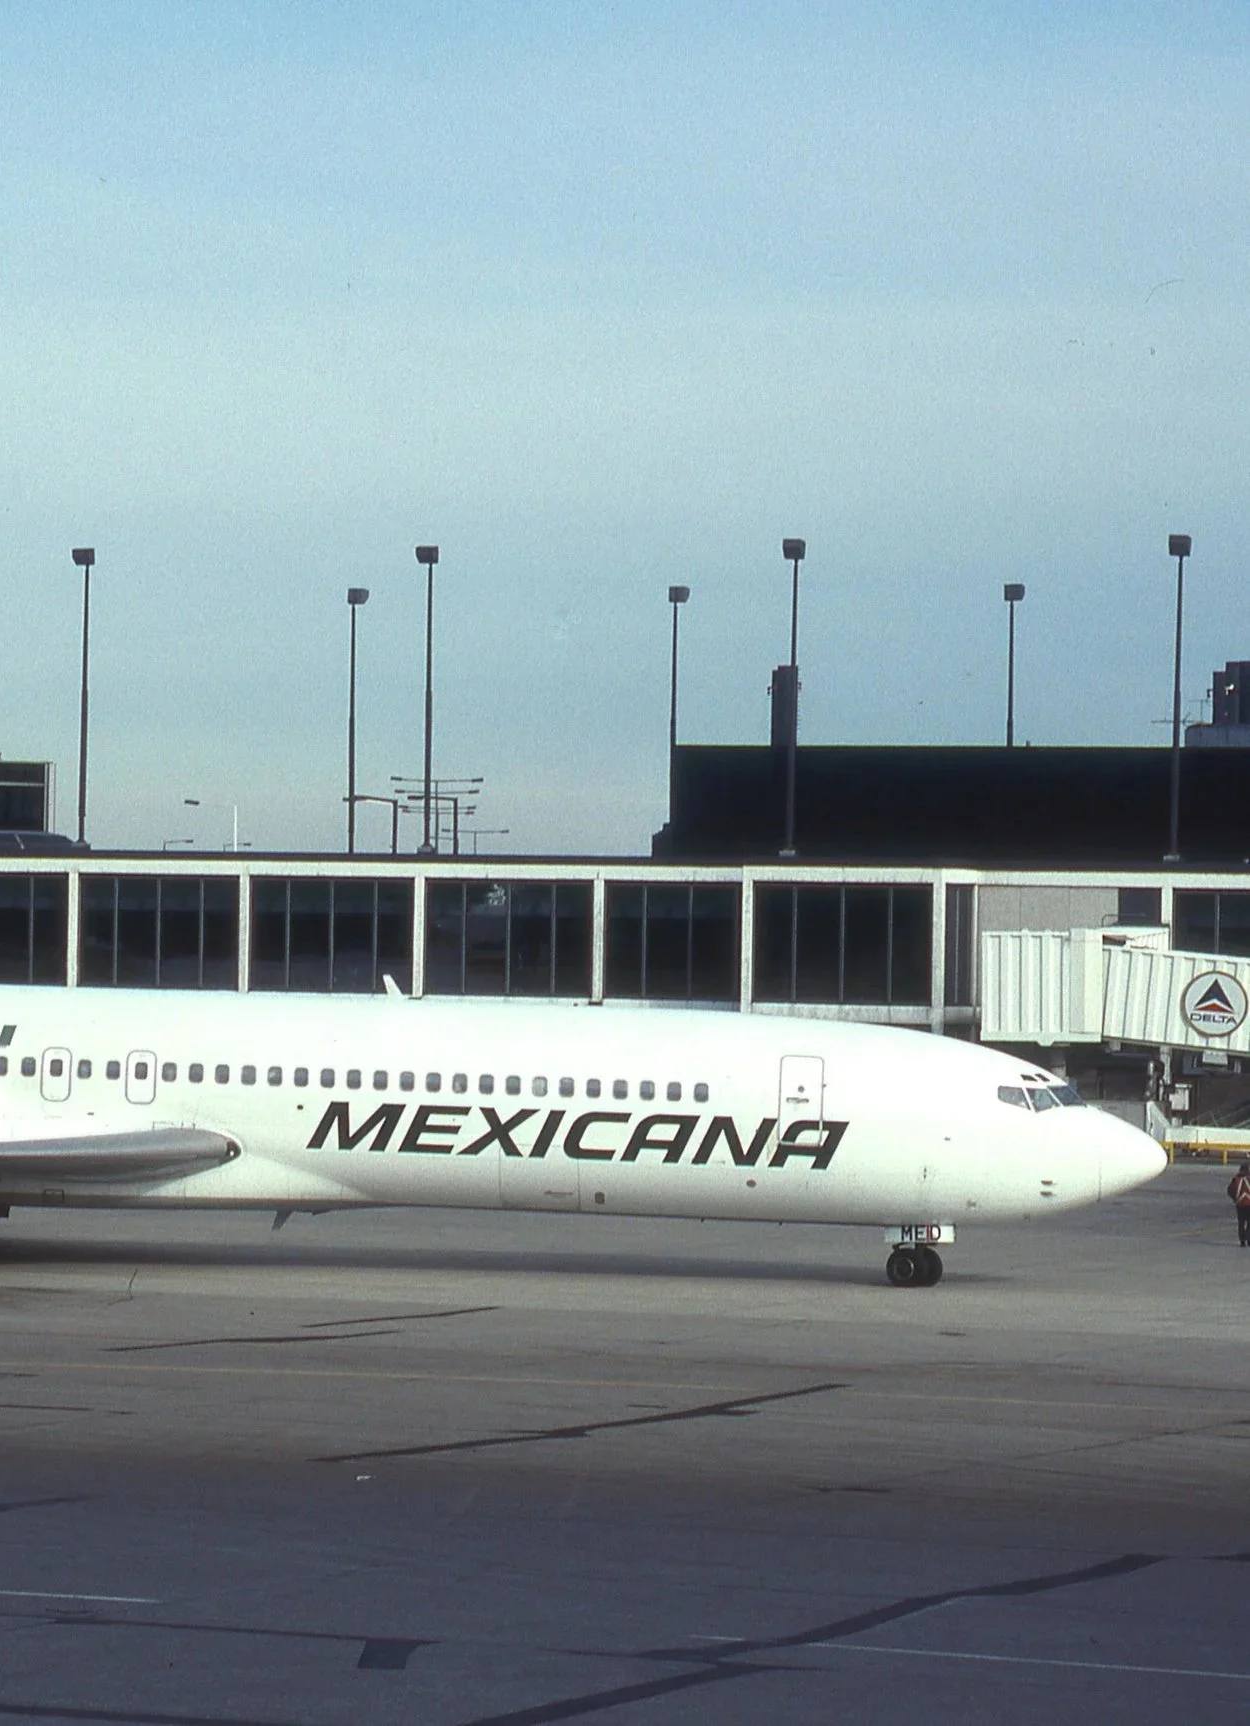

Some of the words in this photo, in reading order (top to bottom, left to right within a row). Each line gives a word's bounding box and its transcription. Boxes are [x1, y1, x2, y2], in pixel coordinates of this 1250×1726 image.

[1191, 1013, 1237, 1024] DELTA
[306, 1101, 849, 1169] MEXICANA
[901, 1225, 941, 1241] MED
